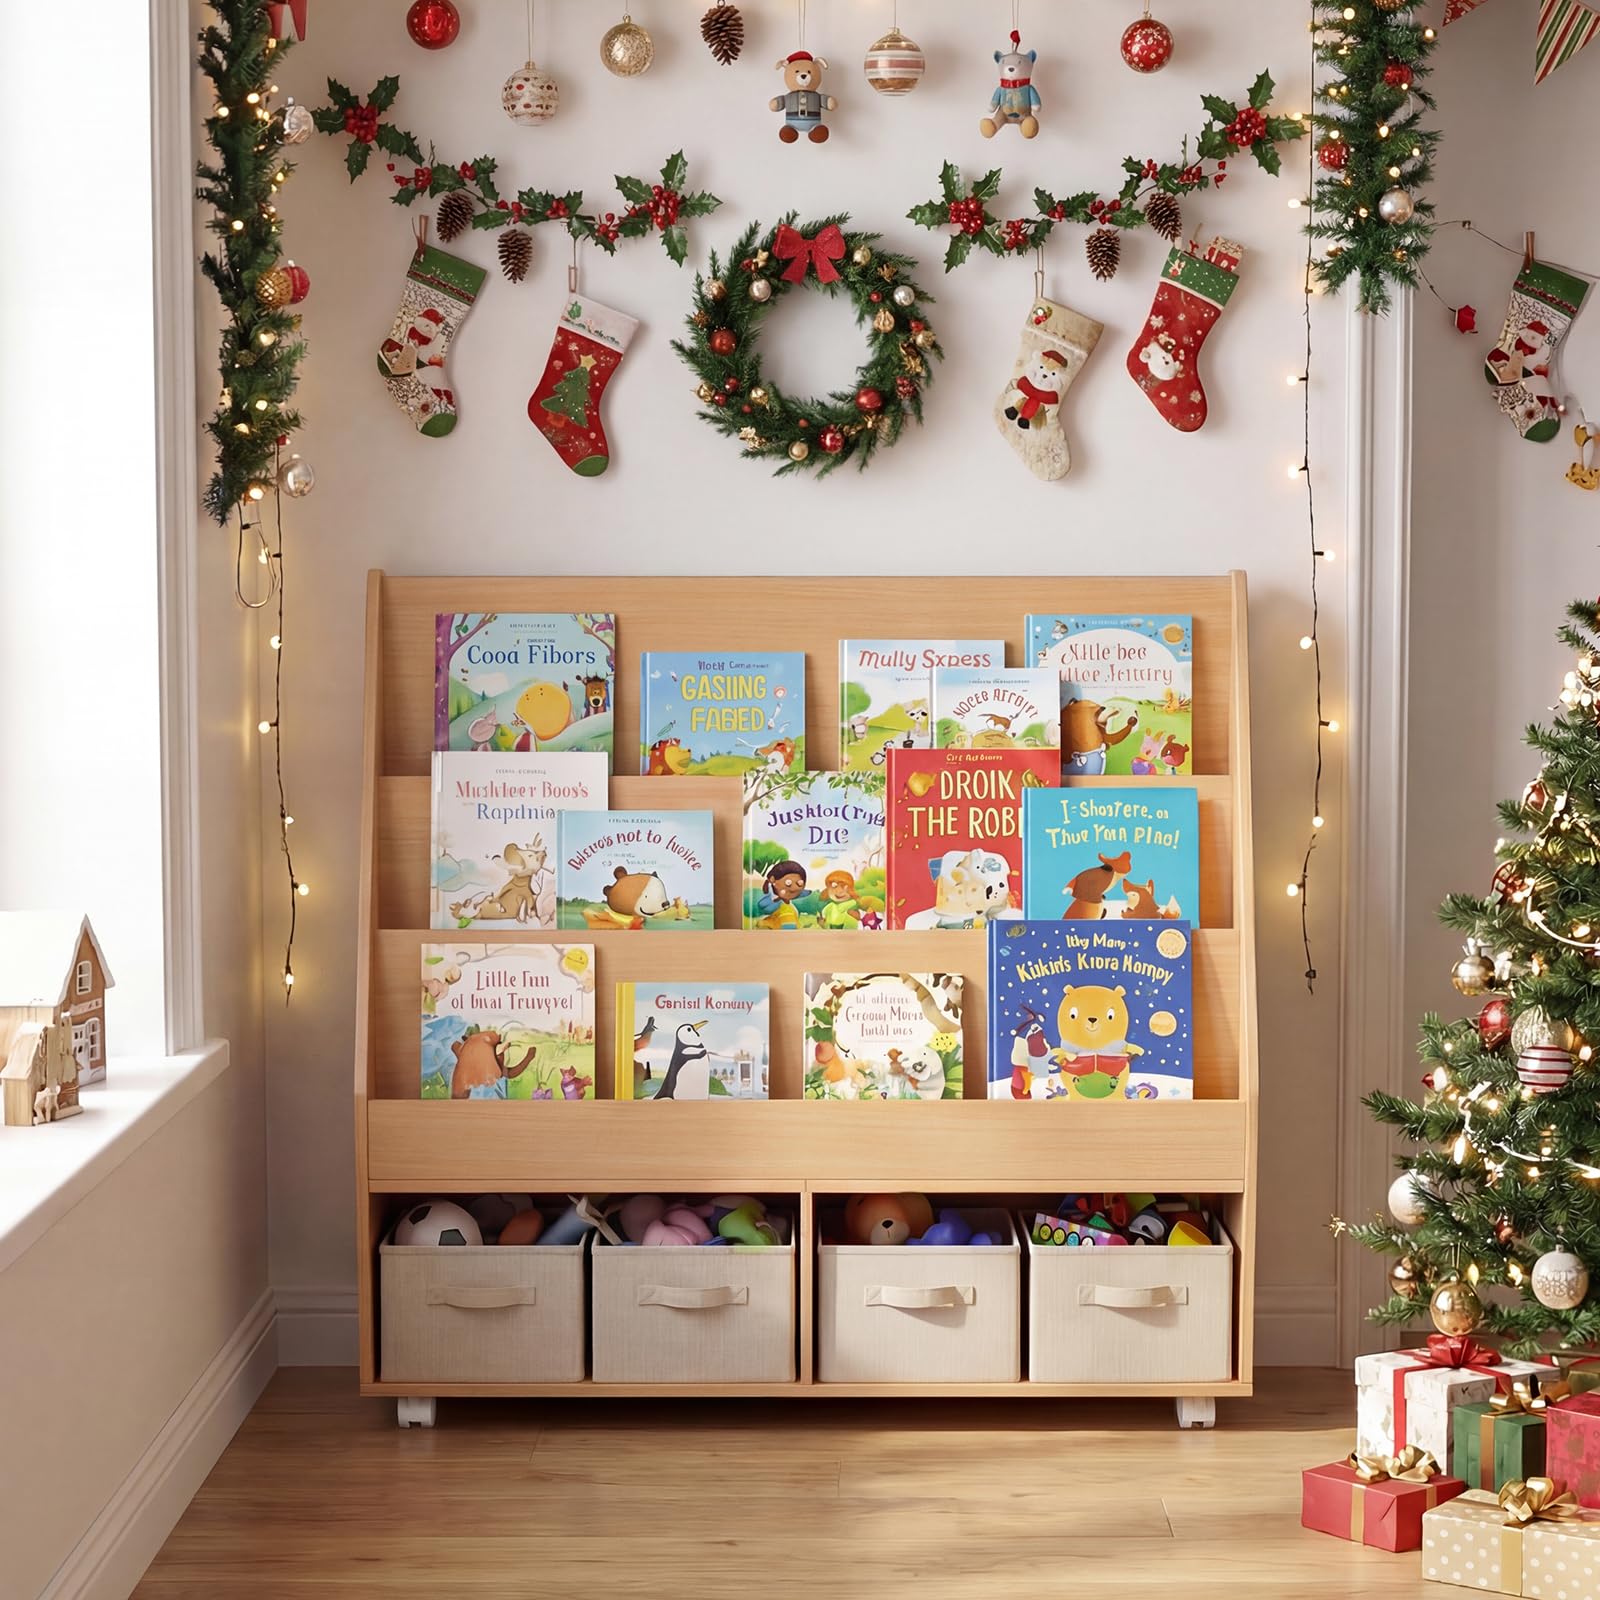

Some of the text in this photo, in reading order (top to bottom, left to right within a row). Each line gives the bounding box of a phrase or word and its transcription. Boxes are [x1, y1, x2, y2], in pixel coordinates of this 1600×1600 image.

[528, 645, 596, 664] Fibors
[859, 650, 917, 672] Mully
[907, 806, 959, 837] THE
[647, 829, 662, 843] to
